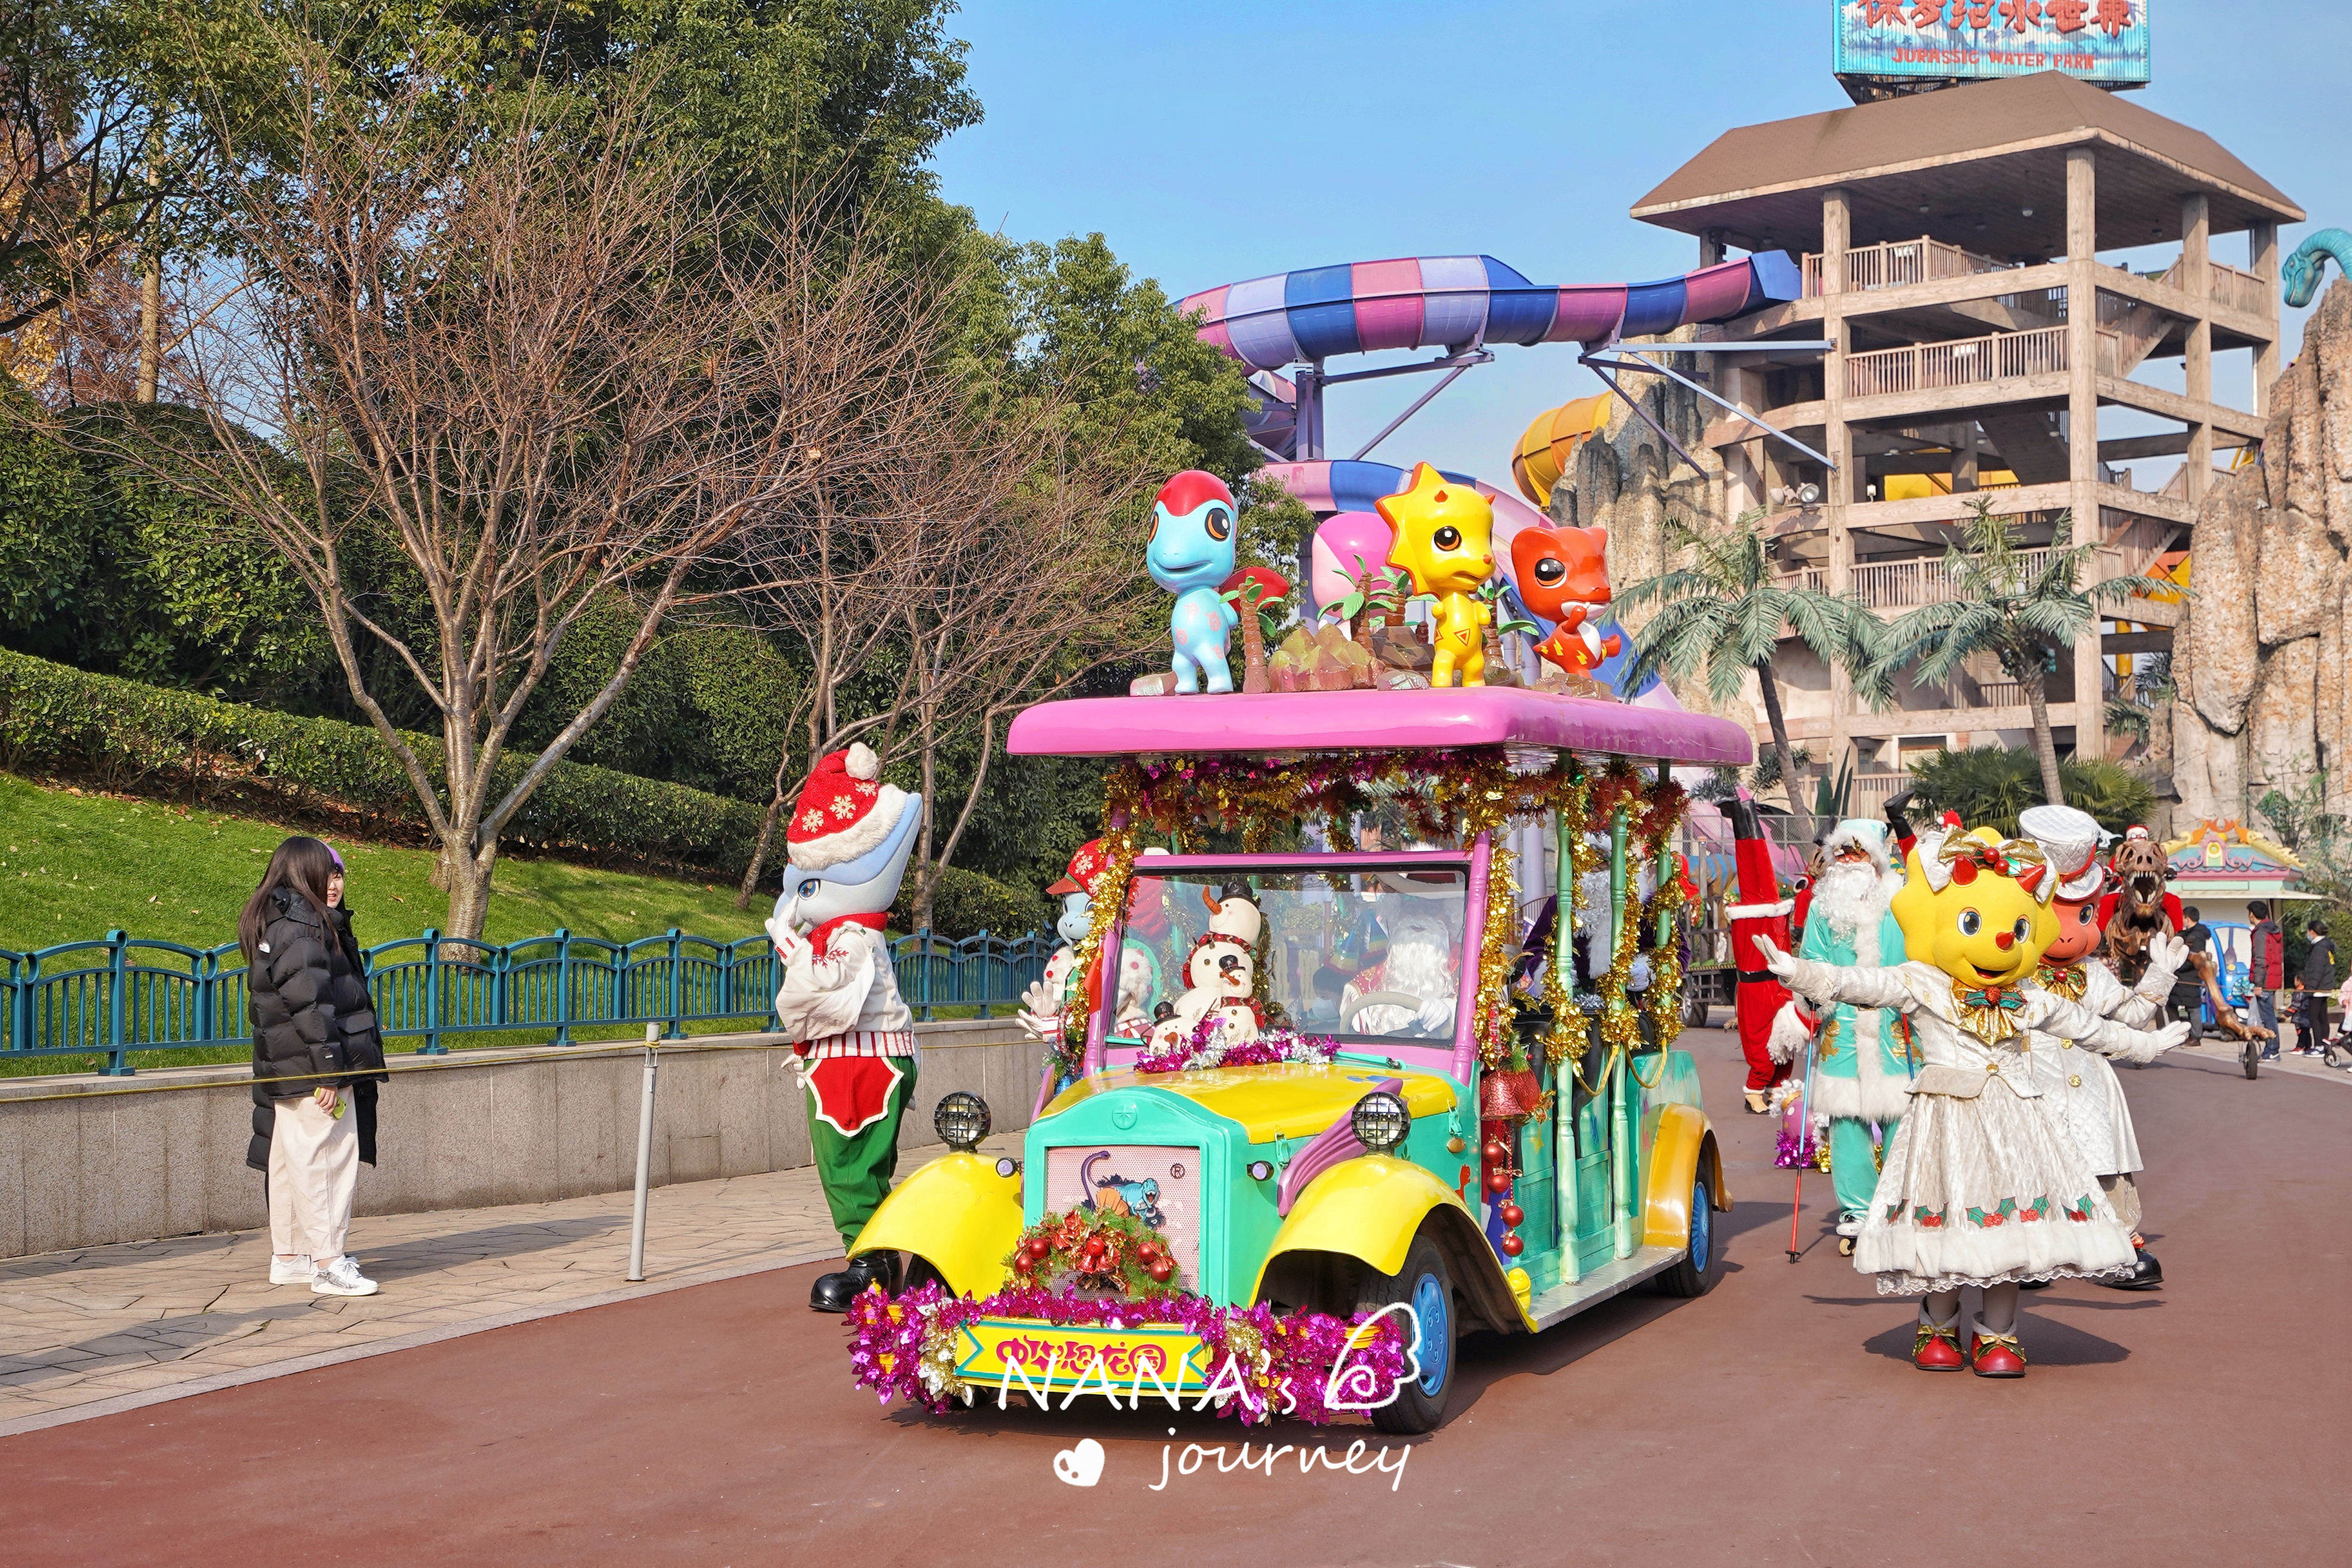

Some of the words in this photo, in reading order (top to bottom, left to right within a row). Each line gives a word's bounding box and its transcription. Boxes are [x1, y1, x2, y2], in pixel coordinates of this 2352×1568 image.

[1892, 47, 1980, 64] JURASSIC
[1989, 51, 2045, 67] WATER
[2053, 54, 2095, 69] PARK
